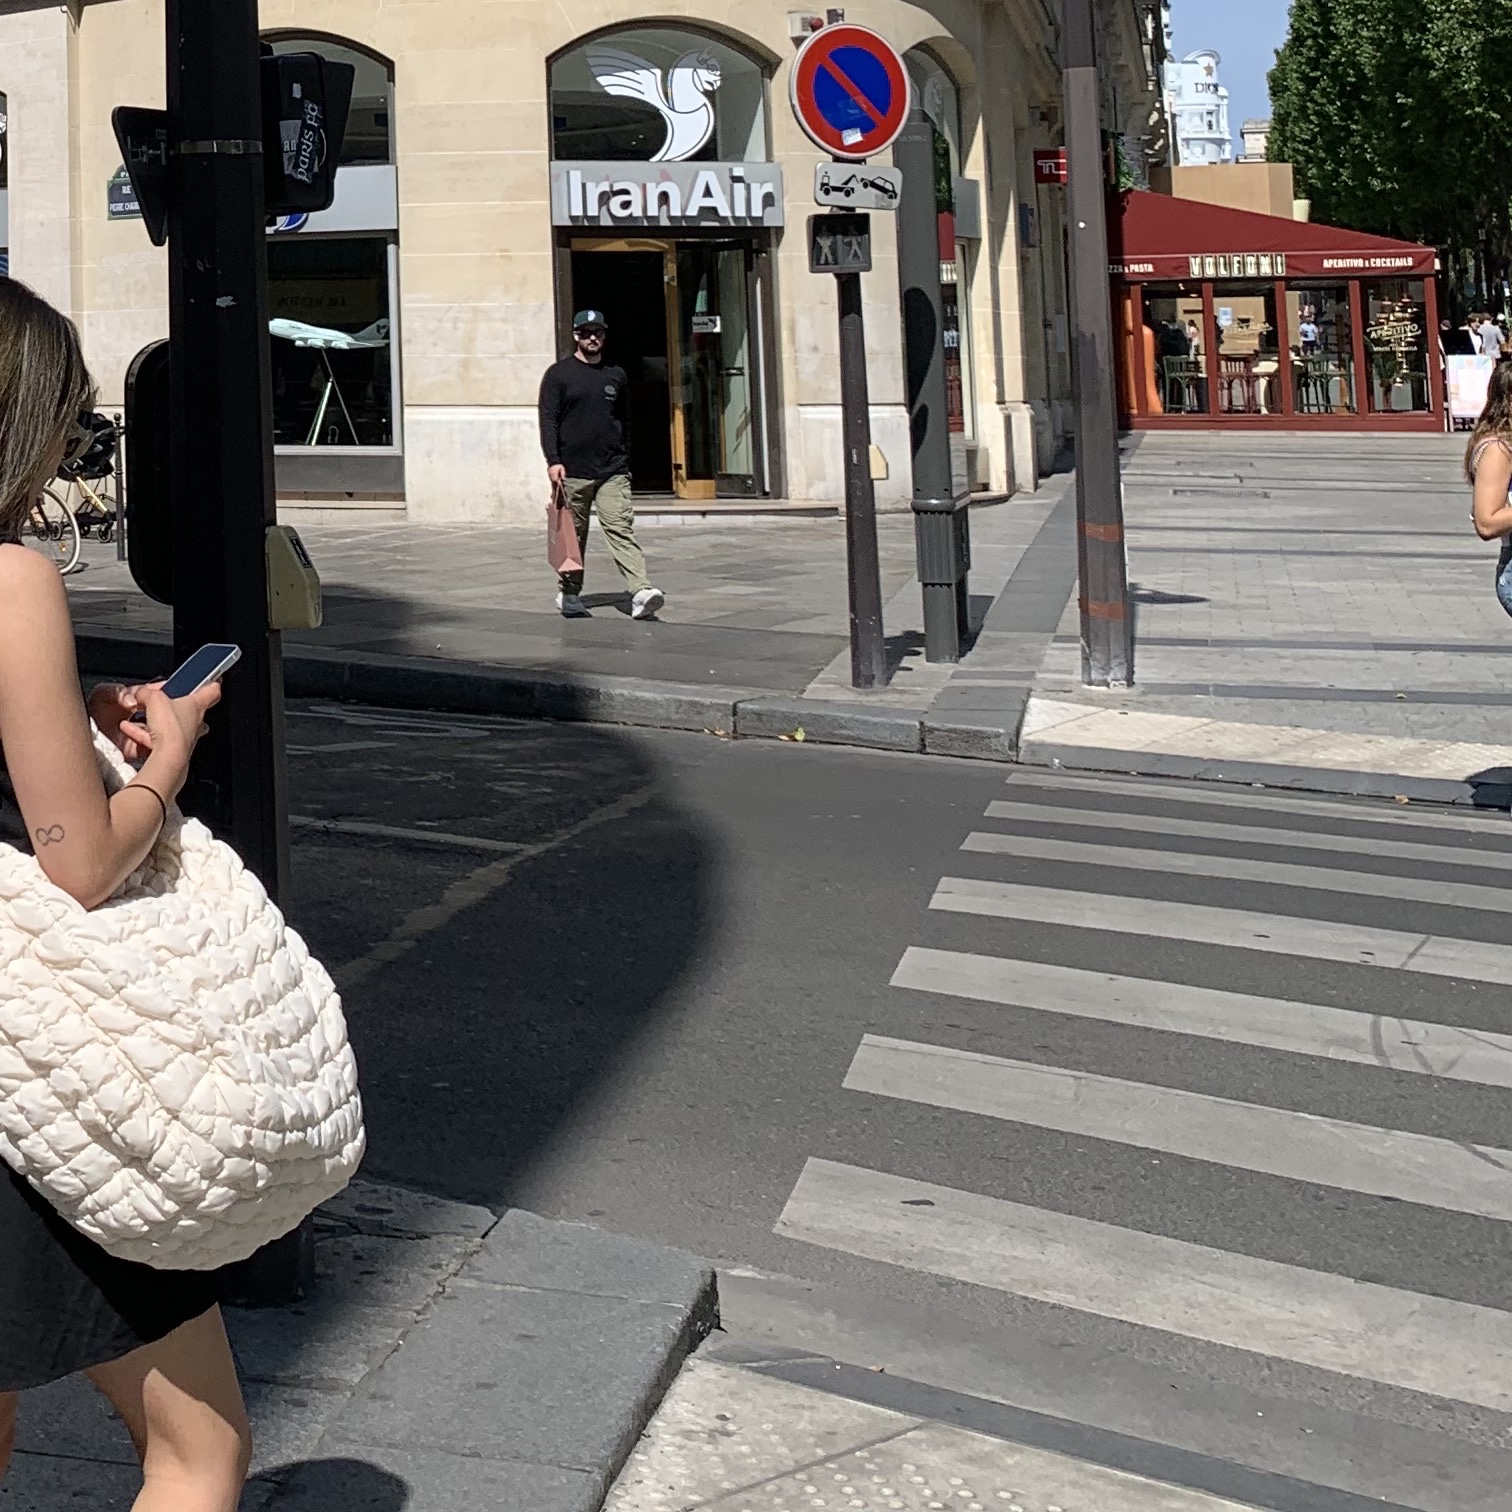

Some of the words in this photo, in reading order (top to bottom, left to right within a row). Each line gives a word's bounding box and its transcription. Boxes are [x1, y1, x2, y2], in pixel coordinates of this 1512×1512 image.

[568, 167, 774, 218] IranAir
[1189, 254, 1285, 277] VOLFONI
[1370, 256, 1414, 268] COCKTAILS
